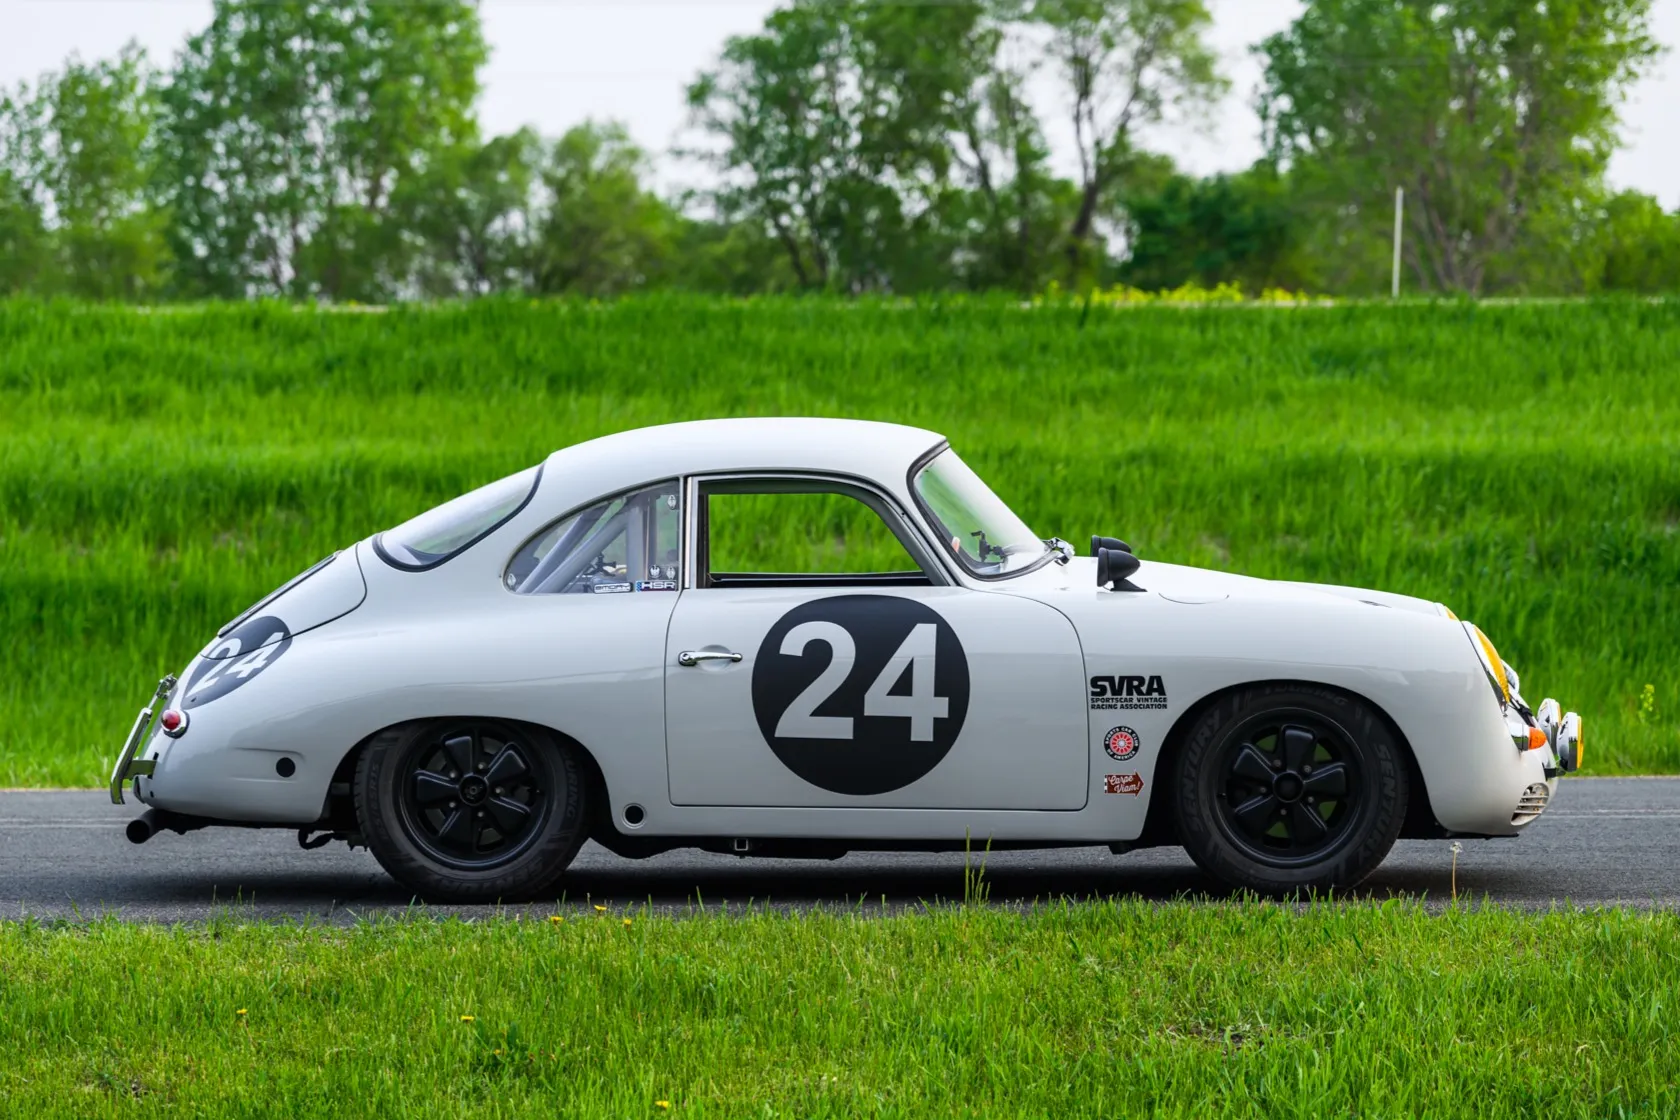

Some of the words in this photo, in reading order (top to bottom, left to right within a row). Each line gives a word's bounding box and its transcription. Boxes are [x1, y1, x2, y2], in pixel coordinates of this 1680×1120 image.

[641, 581, 676, 589] HSR
[185, 632, 284, 698] 24
[775, 620, 949, 742] 24
[1090, 675, 1167, 697] SVRA
[1131, 733, 1139, 747] CLUB
[1181, 708, 1221, 833] SENTURY
[1108, 775, 1134, 786] Carpe
[1113, 781, 1141, 793] Viam!
